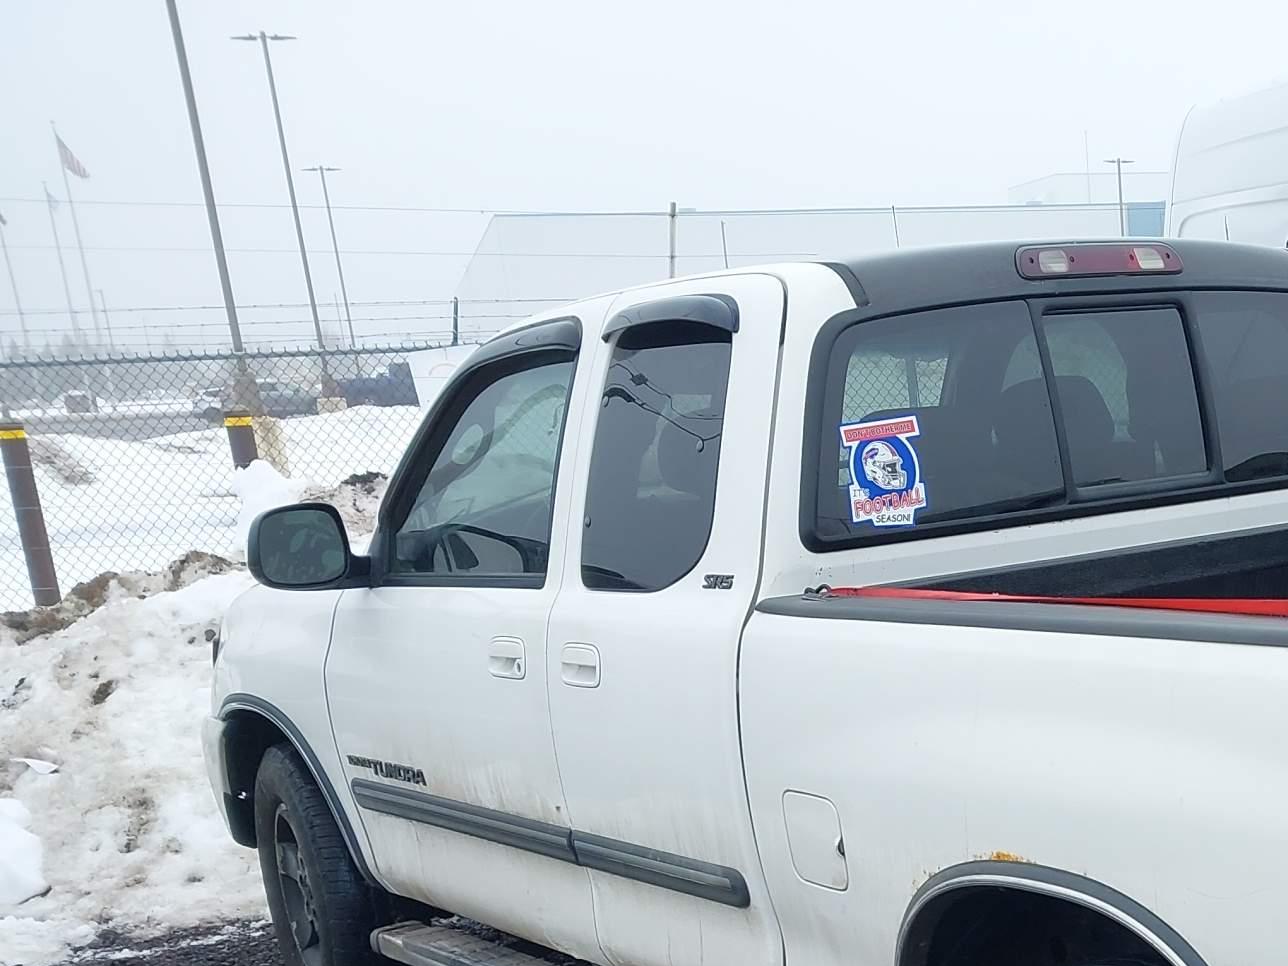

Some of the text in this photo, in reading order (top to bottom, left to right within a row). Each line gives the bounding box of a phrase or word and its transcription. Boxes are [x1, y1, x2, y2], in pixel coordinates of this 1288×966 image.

[847, 422, 912, 439] DON'T BOTHER ME
[852, 488, 870, 498] IT'S
[854, 486, 925, 519] FOOTBALL
[702, 574, 735, 590] SR5
[368, 758, 427, 787] TUNDRA
